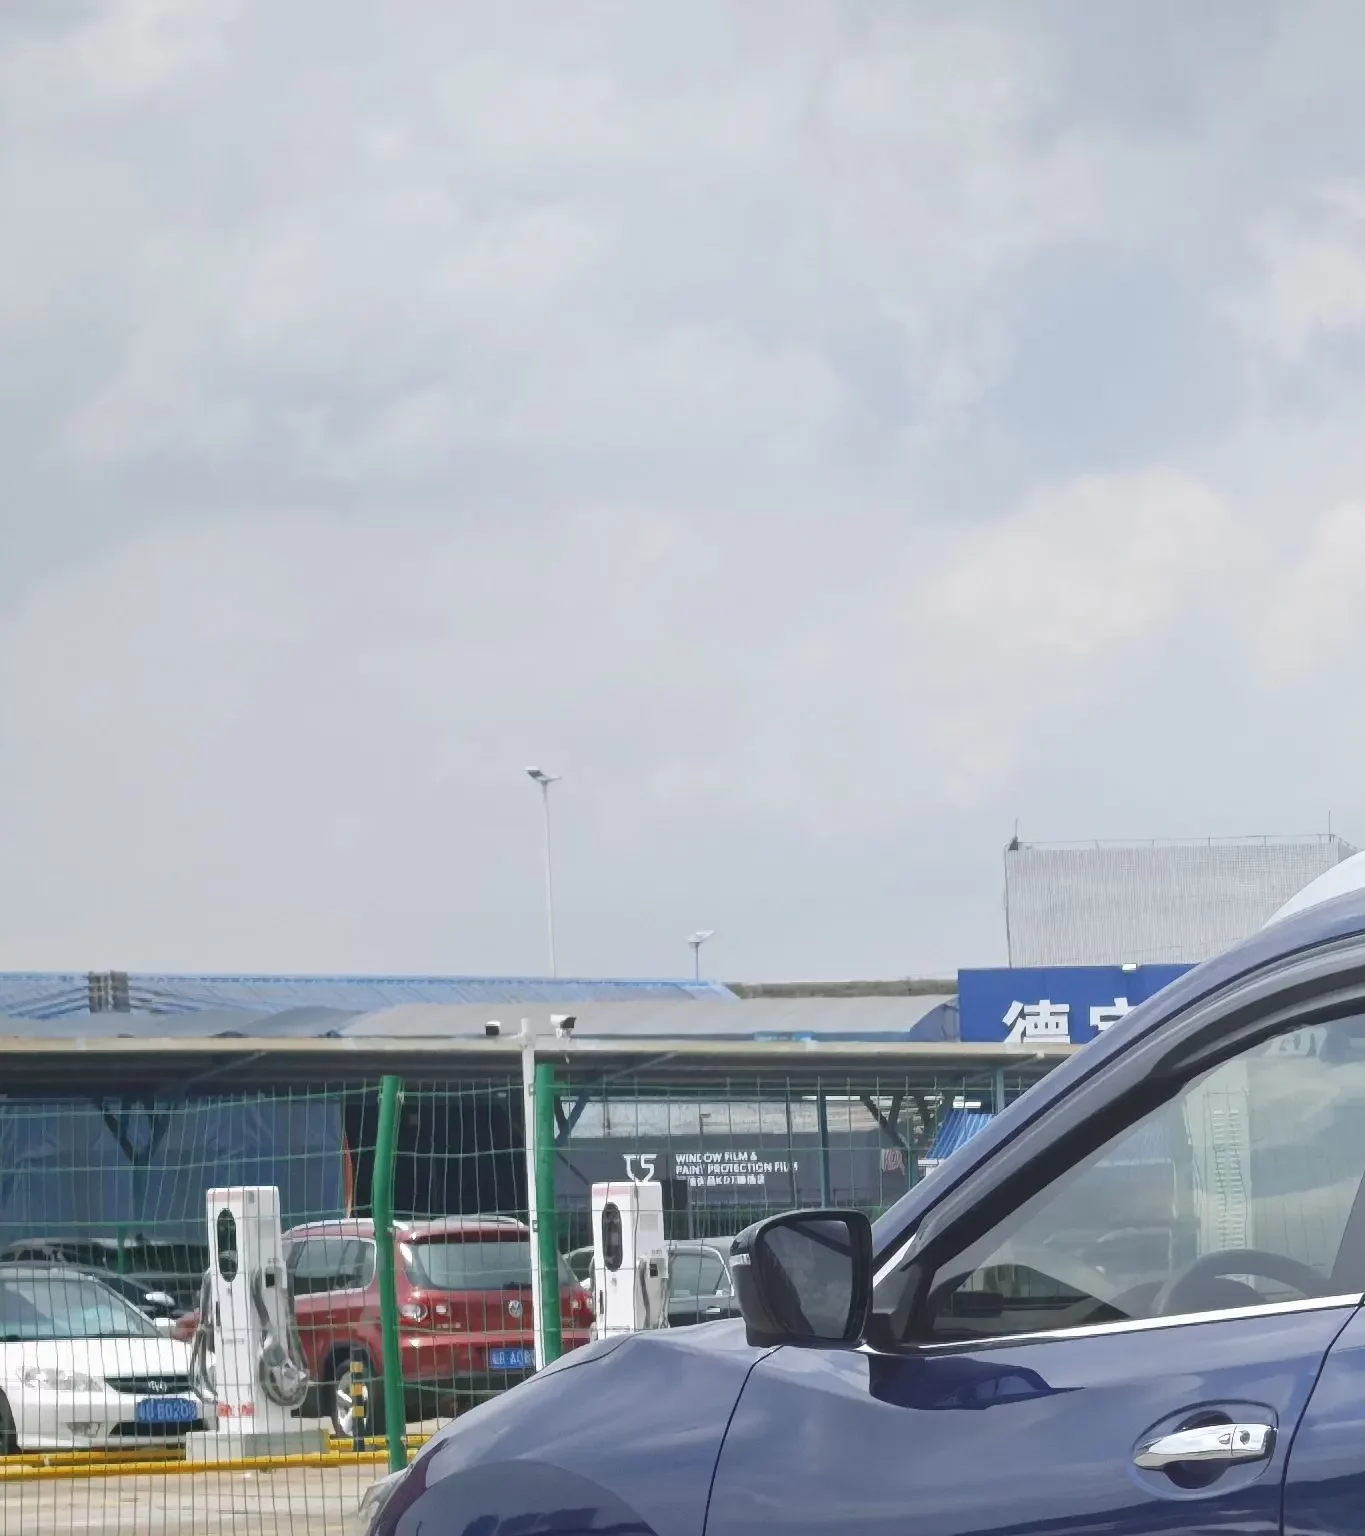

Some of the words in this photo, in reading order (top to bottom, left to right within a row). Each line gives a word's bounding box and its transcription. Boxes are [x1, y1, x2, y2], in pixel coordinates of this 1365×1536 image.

[675, 1152, 723, 1164] WINDOW
[724, 1151, 748, 1162] FILM
[707, 1162, 773, 1175] PROTECTION
